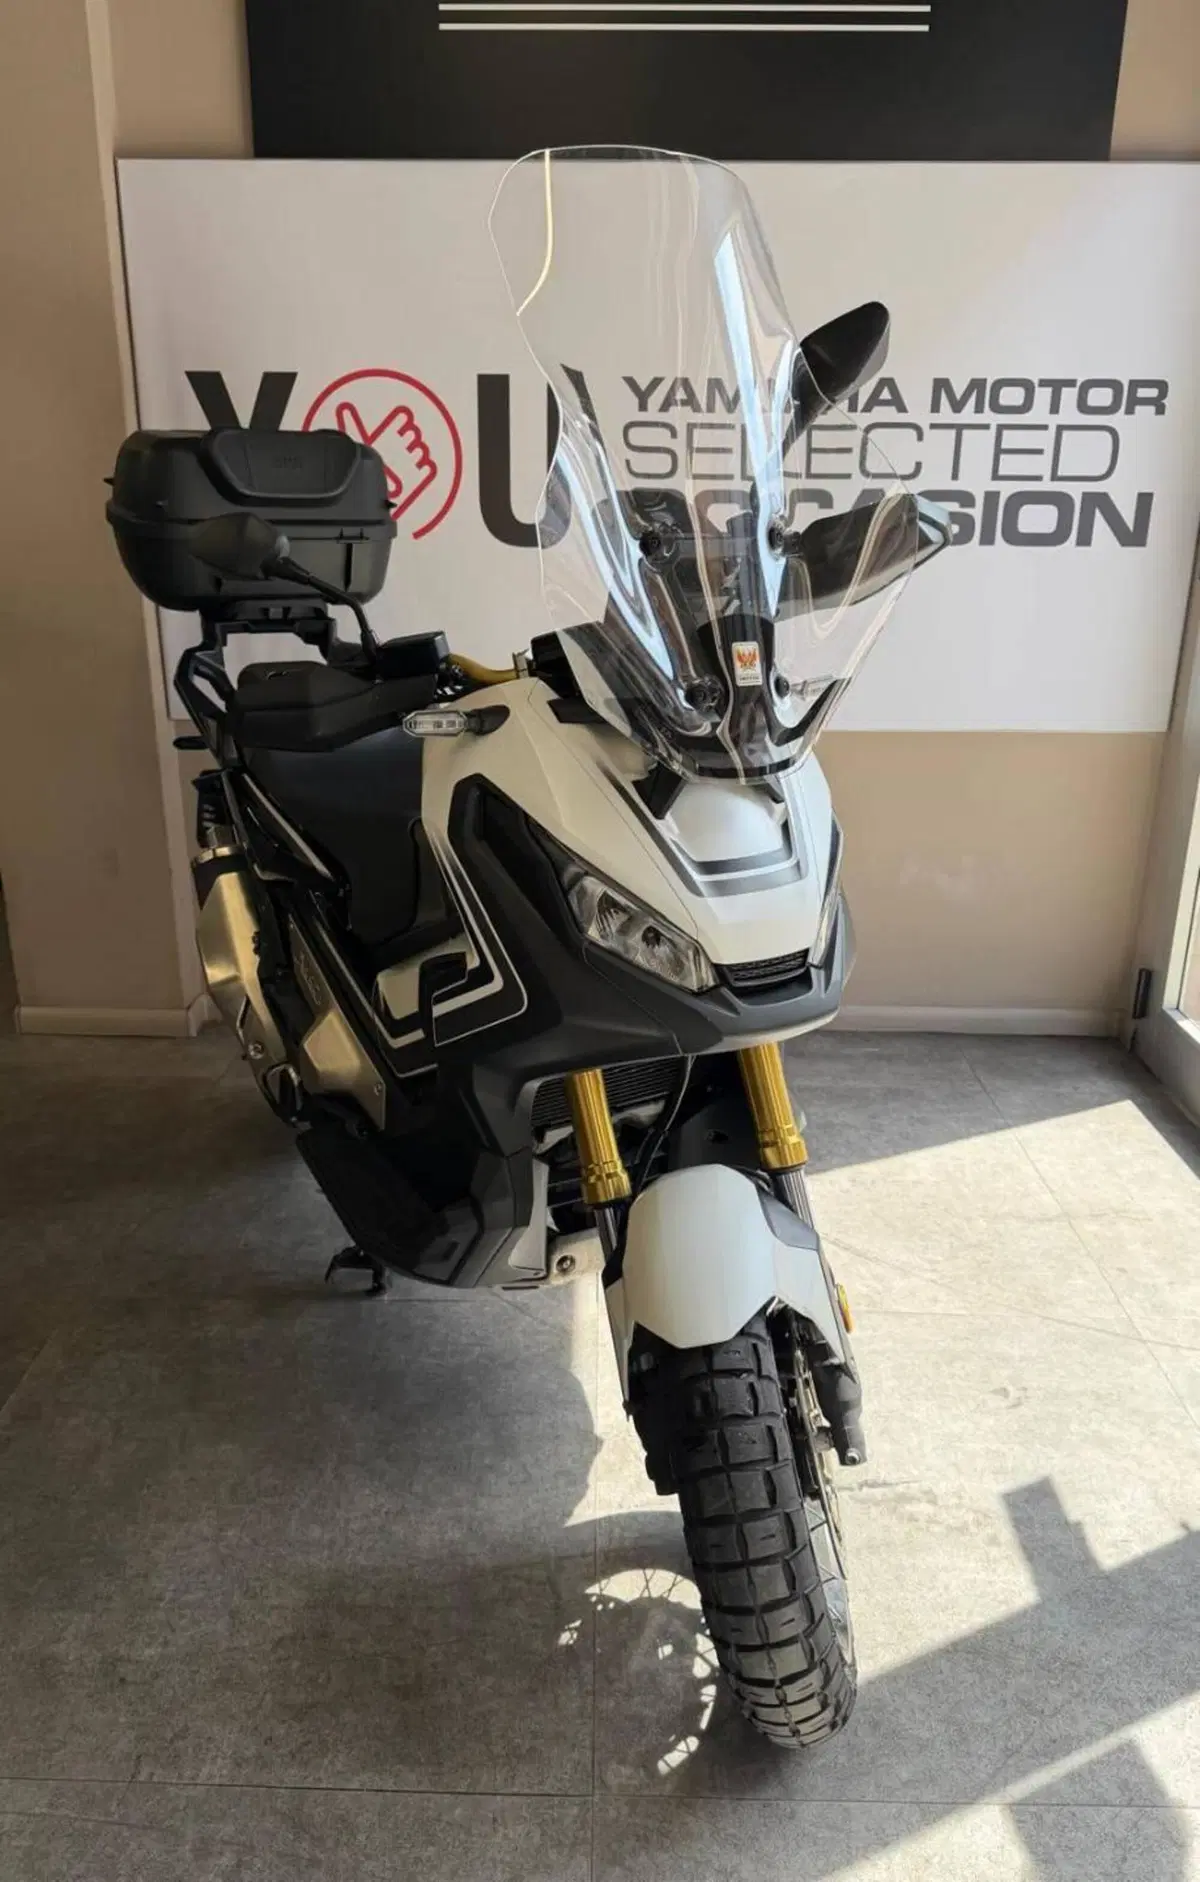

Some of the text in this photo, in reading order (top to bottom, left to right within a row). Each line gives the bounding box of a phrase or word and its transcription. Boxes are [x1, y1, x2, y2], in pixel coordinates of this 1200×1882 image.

[621, 376, 1169, 416] YAMA MOTOR
[622, 421, 1121, 482] SELECTED
[626, 487, 1154, 548] CCSION
